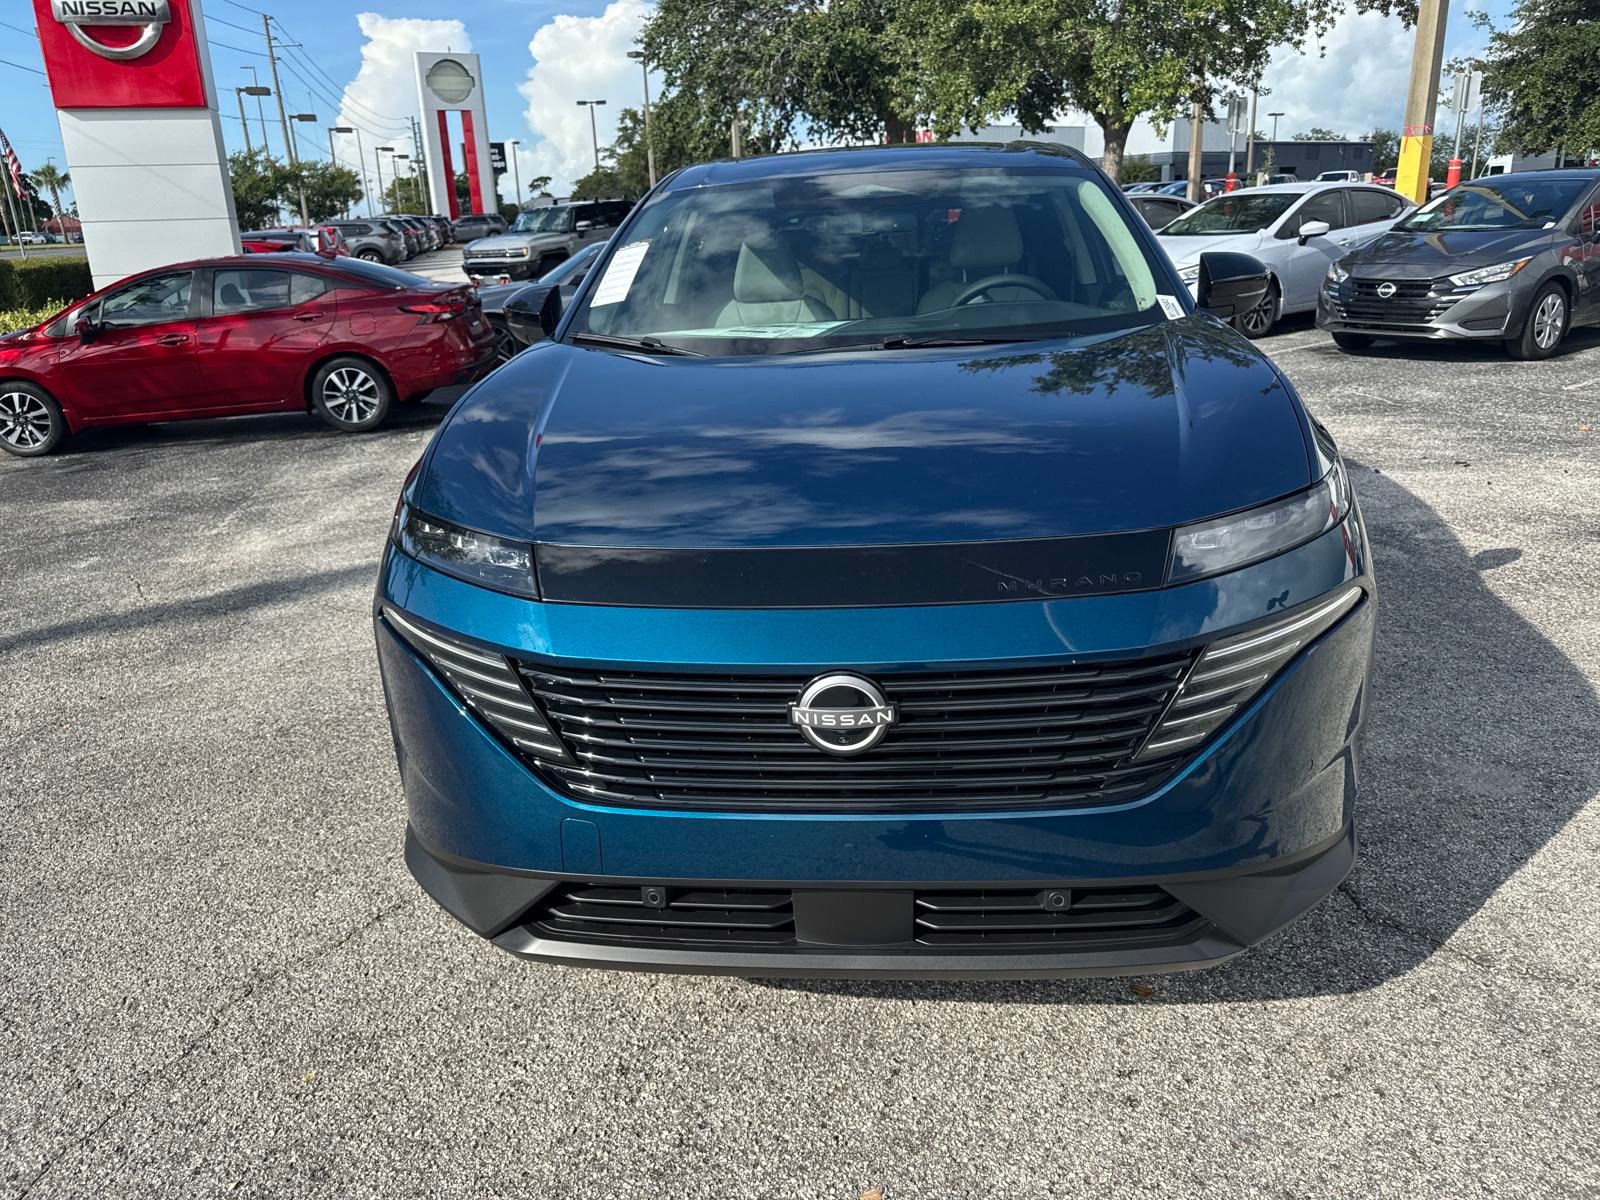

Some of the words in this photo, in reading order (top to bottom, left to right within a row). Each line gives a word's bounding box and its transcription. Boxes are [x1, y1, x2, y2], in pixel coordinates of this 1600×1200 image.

[62, 1, 157, 16] NISSAN
[997, 571, 1142, 592] MURANO
[794, 709, 892, 726] NISSAN
